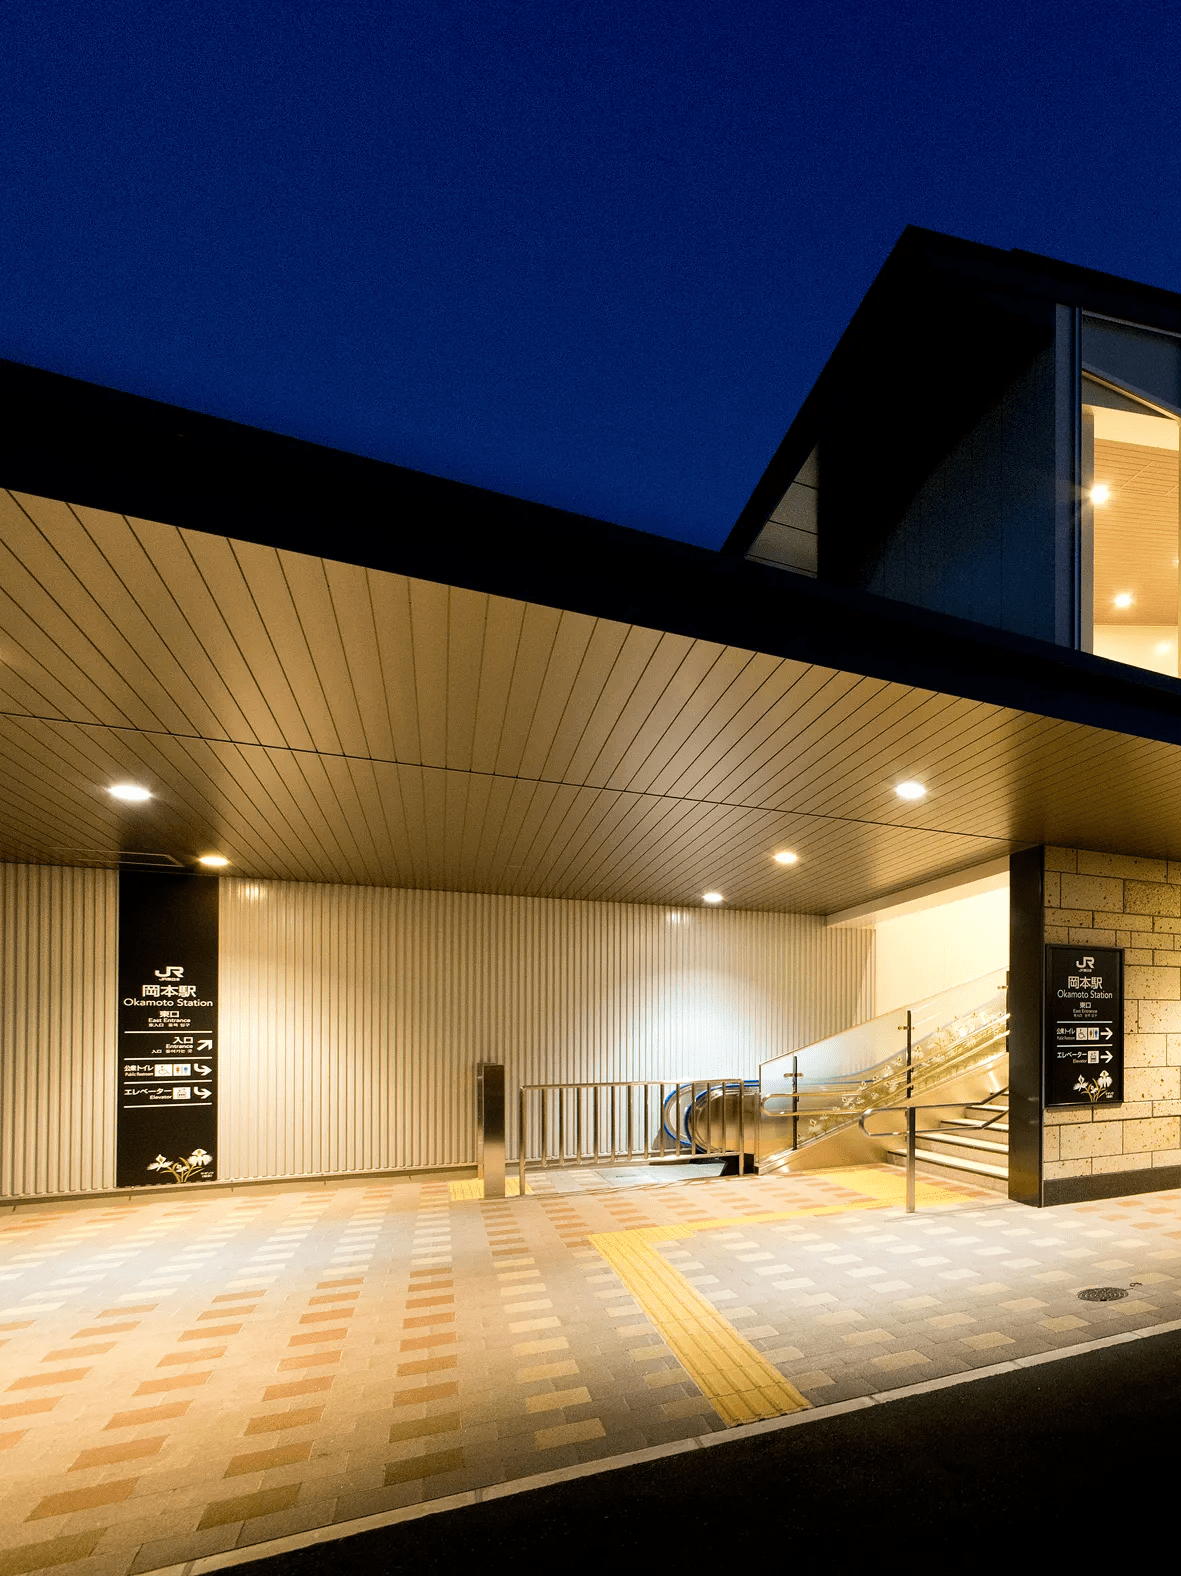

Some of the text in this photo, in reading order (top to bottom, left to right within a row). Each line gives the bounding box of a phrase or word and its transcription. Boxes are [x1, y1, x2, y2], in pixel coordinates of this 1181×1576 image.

[1076, 956, 1095, 969] JR
[154, 966, 184, 978] JR
[1068, 976, 1103, 990] 岡本駅
[142, 984, 197, 998] 岡本駅
[1057, 989, 1113, 999] Okamoto Station
[123, 998, 213, 1007] Okamoto Station
[159, 1010, 180, 1018] 東口
[172, 1036, 193, 1044] 入口
[124, 1064, 154, 1072] 公衆トイレ
[124, 1087, 172, 1096] エレベーター
